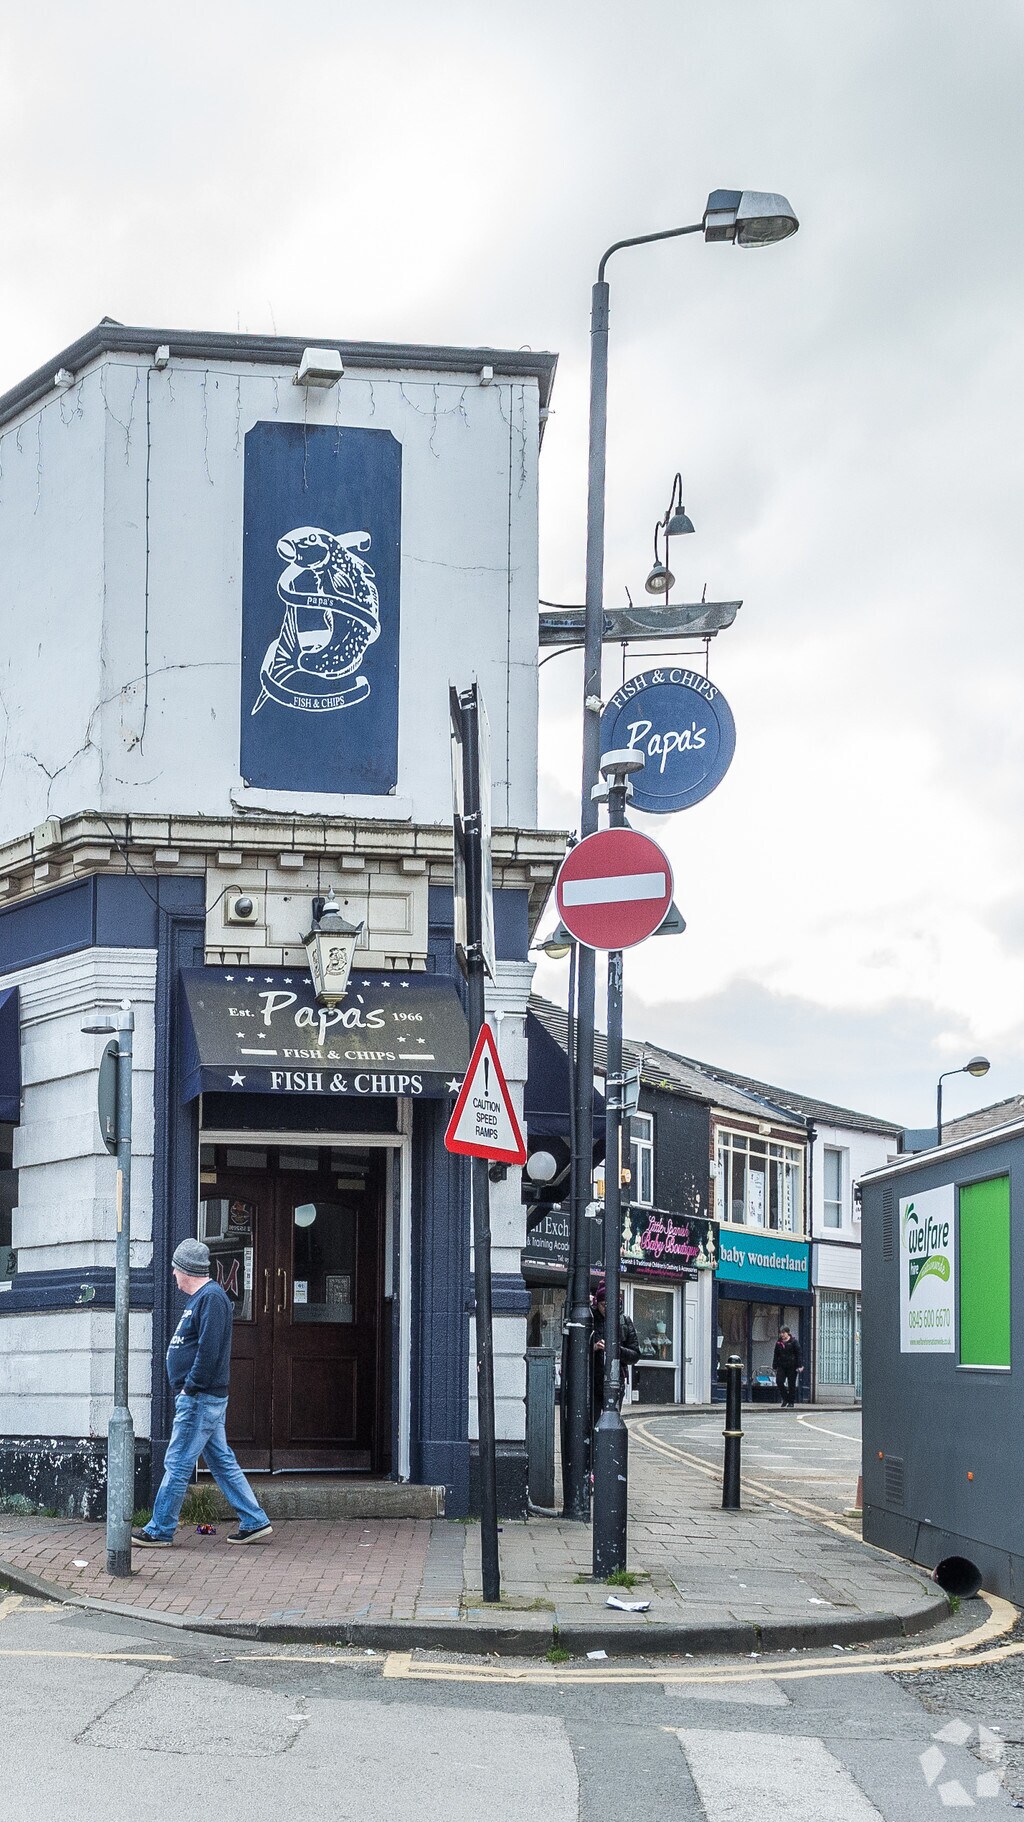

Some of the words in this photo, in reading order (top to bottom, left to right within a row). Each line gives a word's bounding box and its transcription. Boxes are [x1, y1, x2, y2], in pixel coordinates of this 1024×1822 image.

[307, 596, 334, 606] papa's
[612, 675, 647, 710] FISH
[651, 669, 665, 684] &
[669, 669, 719, 700] CHIPS
[293, 696, 312, 708] FISH
[313, 699, 320, 708] &
[321, 695, 345, 708] CHIPS
[627, 720, 707, 774] Papa's
[228, 1007, 255, 1017] Est.
[258, 990, 386, 1045] Papa's
[392, 1012, 423, 1021] 1966
[283, 1048, 323, 1059] FISH
[327, 1050, 340, 1059] &
[344, 1050, 396, 1061] CHIPS
[270, 1071, 324, 1092] FISH
[329, 1074, 348, 1092] &
[354, 1073, 423, 1094] CHIPS
[472, 1097, 501, 1113] CAUTION
[476, 1112, 498, 1126] SPEED
[475, 1125, 498, 1140] RAMPS
[545, 1216, 570, 1237] Exch
[908, 1216, 950, 1257] welfare
[554, 1240, 570, 1251] Acad
[720, 1243, 746, 1267] baby
[747, 1251, 808, 1272] wonderland
[908, 1310, 923, 1329] 0845
[923, 1309, 935, 1328] 600
[935, 1308, 951, 1328] 6670
